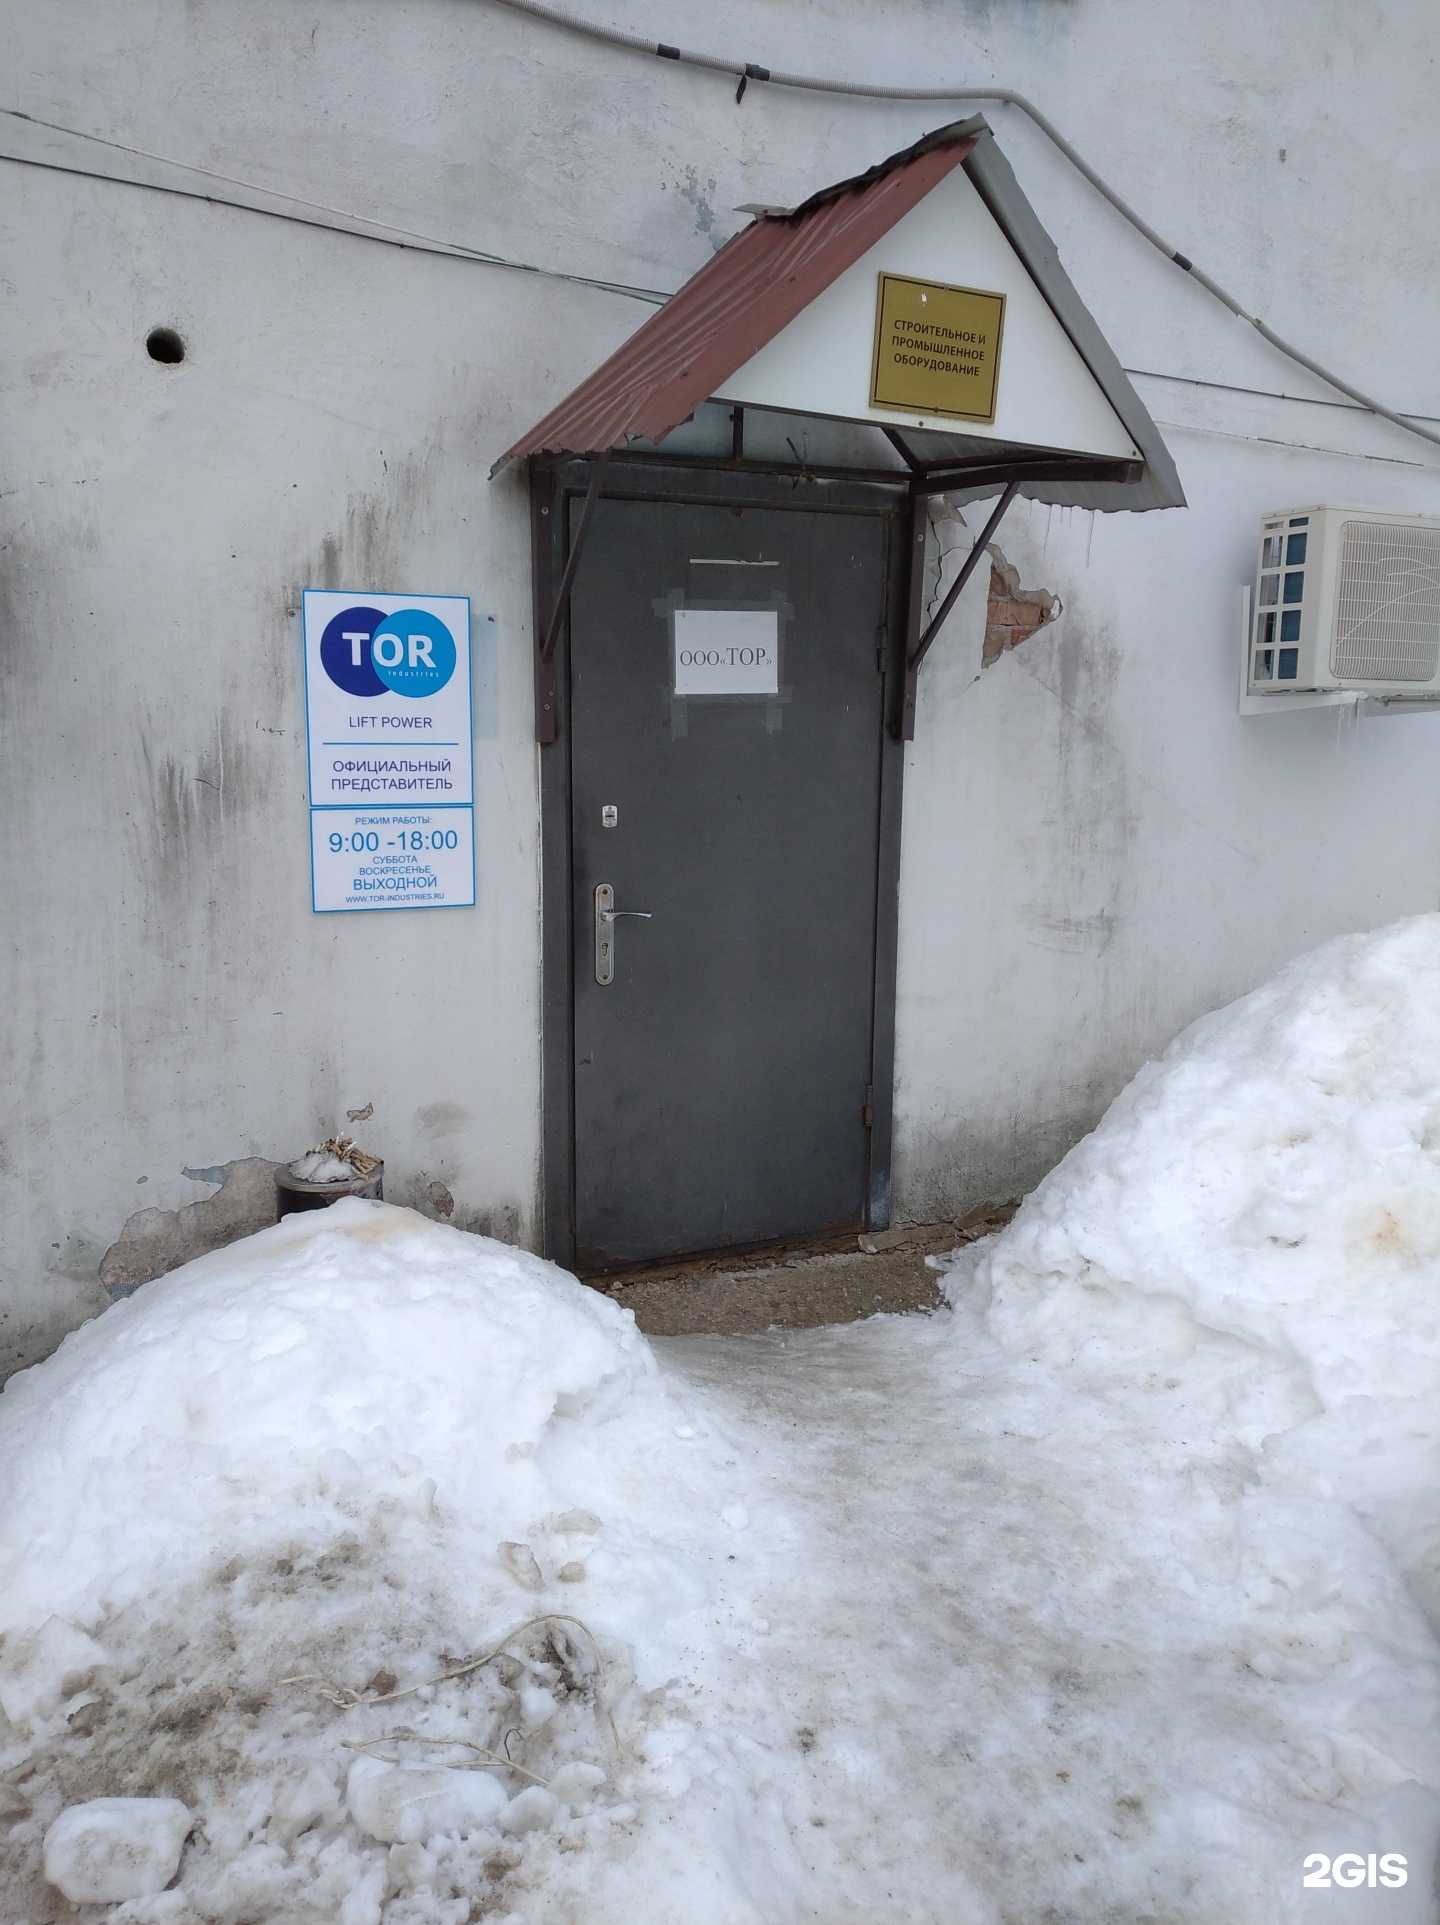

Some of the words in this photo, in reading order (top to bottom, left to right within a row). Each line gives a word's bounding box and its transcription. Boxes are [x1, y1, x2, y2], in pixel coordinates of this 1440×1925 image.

[894, 319, 976, 343] СТРОИТЕЛЬНОЕ
[978, 333, 986, 345] И
[891, 335, 985, 361] ПРОМЫШЛЕННОЕ
[894, 353, 980, 377] ОБОРУДОВАНИЕ
[342, 631, 437, 668] TOR
[349, 716, 377, 728] LIFT
[381, 716, 433, 728] POWER
[332, 758, 452, 775] ОФИЦИАЛЬНЫЙ
[331, 778, 453, 792] ПРЕДСТАВИТЕЛЬ
[354, 817, 390, 825] РЕЖИМ
[328, 832, 379, 853] 9:00
[372, 855, 418, 865] СУББОТА
[359, 865, 431, 876] ВОСКРЕСЕНЬЕ
[352, 875, 438, 891] ВЫХОДНОЙ
